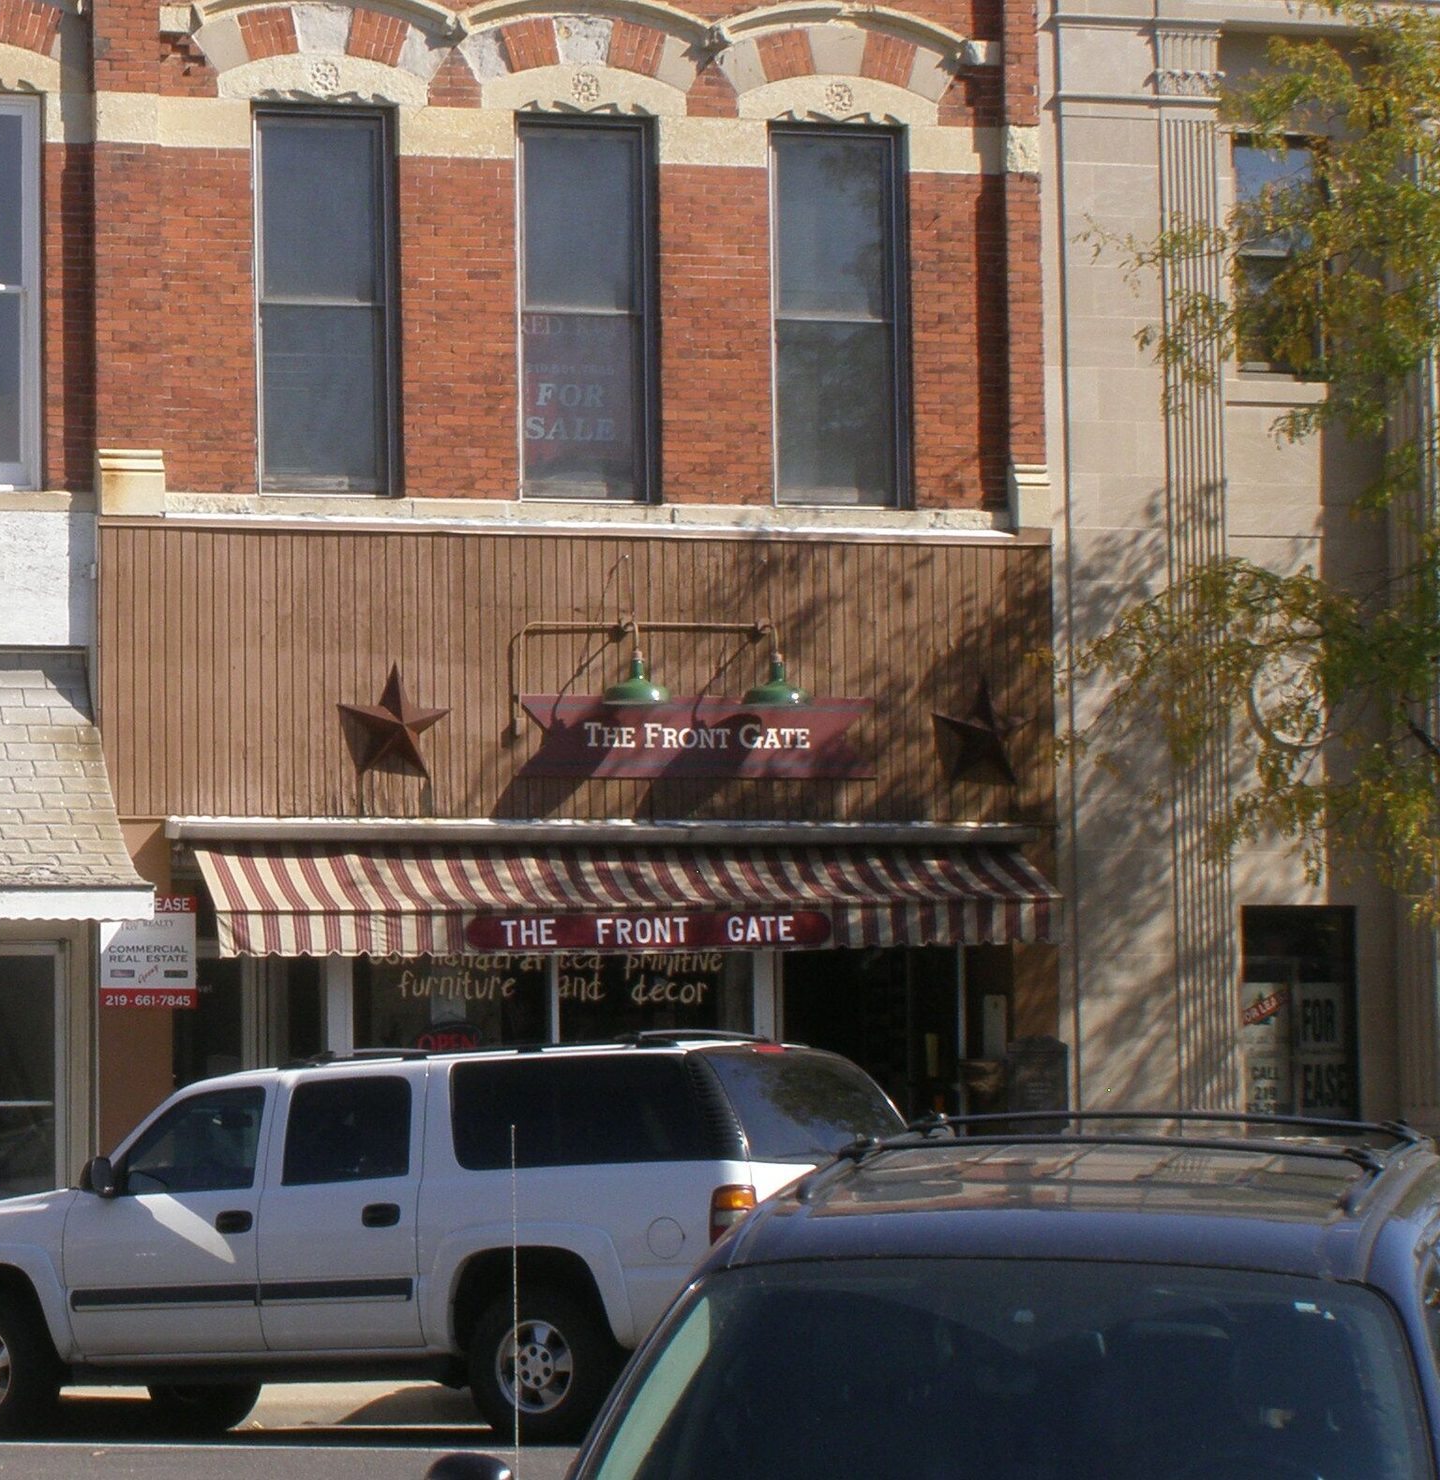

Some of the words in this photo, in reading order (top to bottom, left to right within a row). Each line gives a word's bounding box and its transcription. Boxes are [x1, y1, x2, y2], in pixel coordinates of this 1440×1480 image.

[536, 383, 605, 408] FOR
[526, 417, 616, 441] SALE
[584, 722, 636, 748] THE
[643, 722, 731, 749] FRONT
[739, 724, 811, 749] GATE
[155, 898, 190, 911] EASE
[500, 919, 558, 946] THE
[596, 916, 690, 945] FRONT
[727, 914, 796, 943] GATE
[109, 945, 189, 954] COMMERCIAL
[109, 955, 141, 963] REAL
[146, 954, 188, 963] ESTATE
[399, 969, 518, 1000] furniture
[559, 973, 606, 1001] and
[631, 974, 708, 1005] decor
[1301, 998, 1336, 1043] FOR
[416, 1031, 477, 1050] OPEN
[1303, 1063, 1348, 1108] EASE
